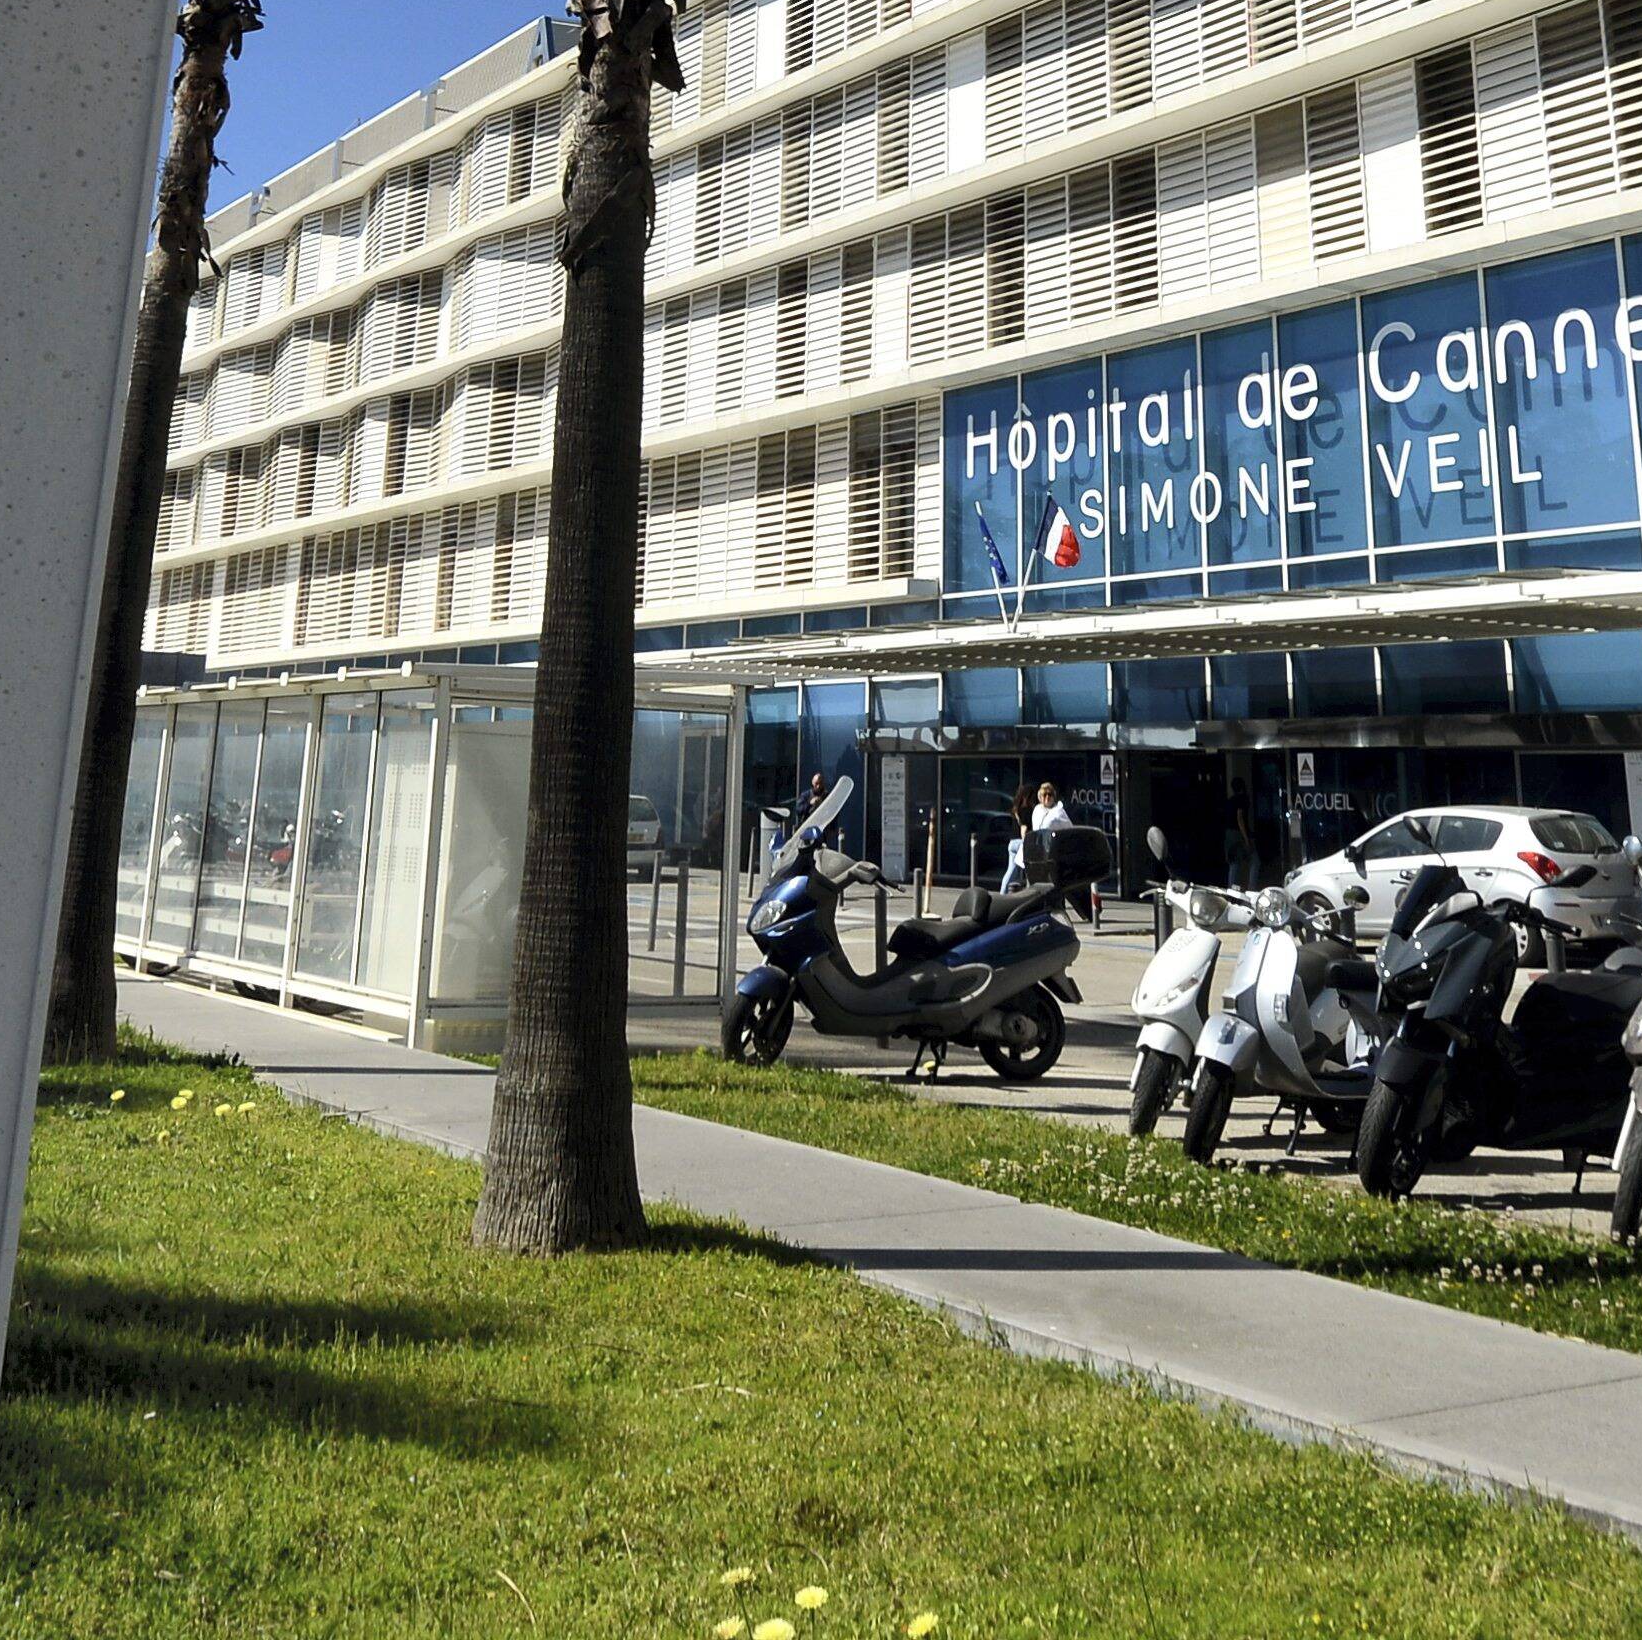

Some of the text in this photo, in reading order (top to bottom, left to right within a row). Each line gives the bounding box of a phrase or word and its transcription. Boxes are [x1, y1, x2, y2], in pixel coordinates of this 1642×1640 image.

[965, 368, 1194, 482] Hôpital
[1236, 351, 1319, 430] de
[1079, 424, 1543, 539] SIMONE VEIL
[1294, 792, 1355, 811] ACCUEIL
